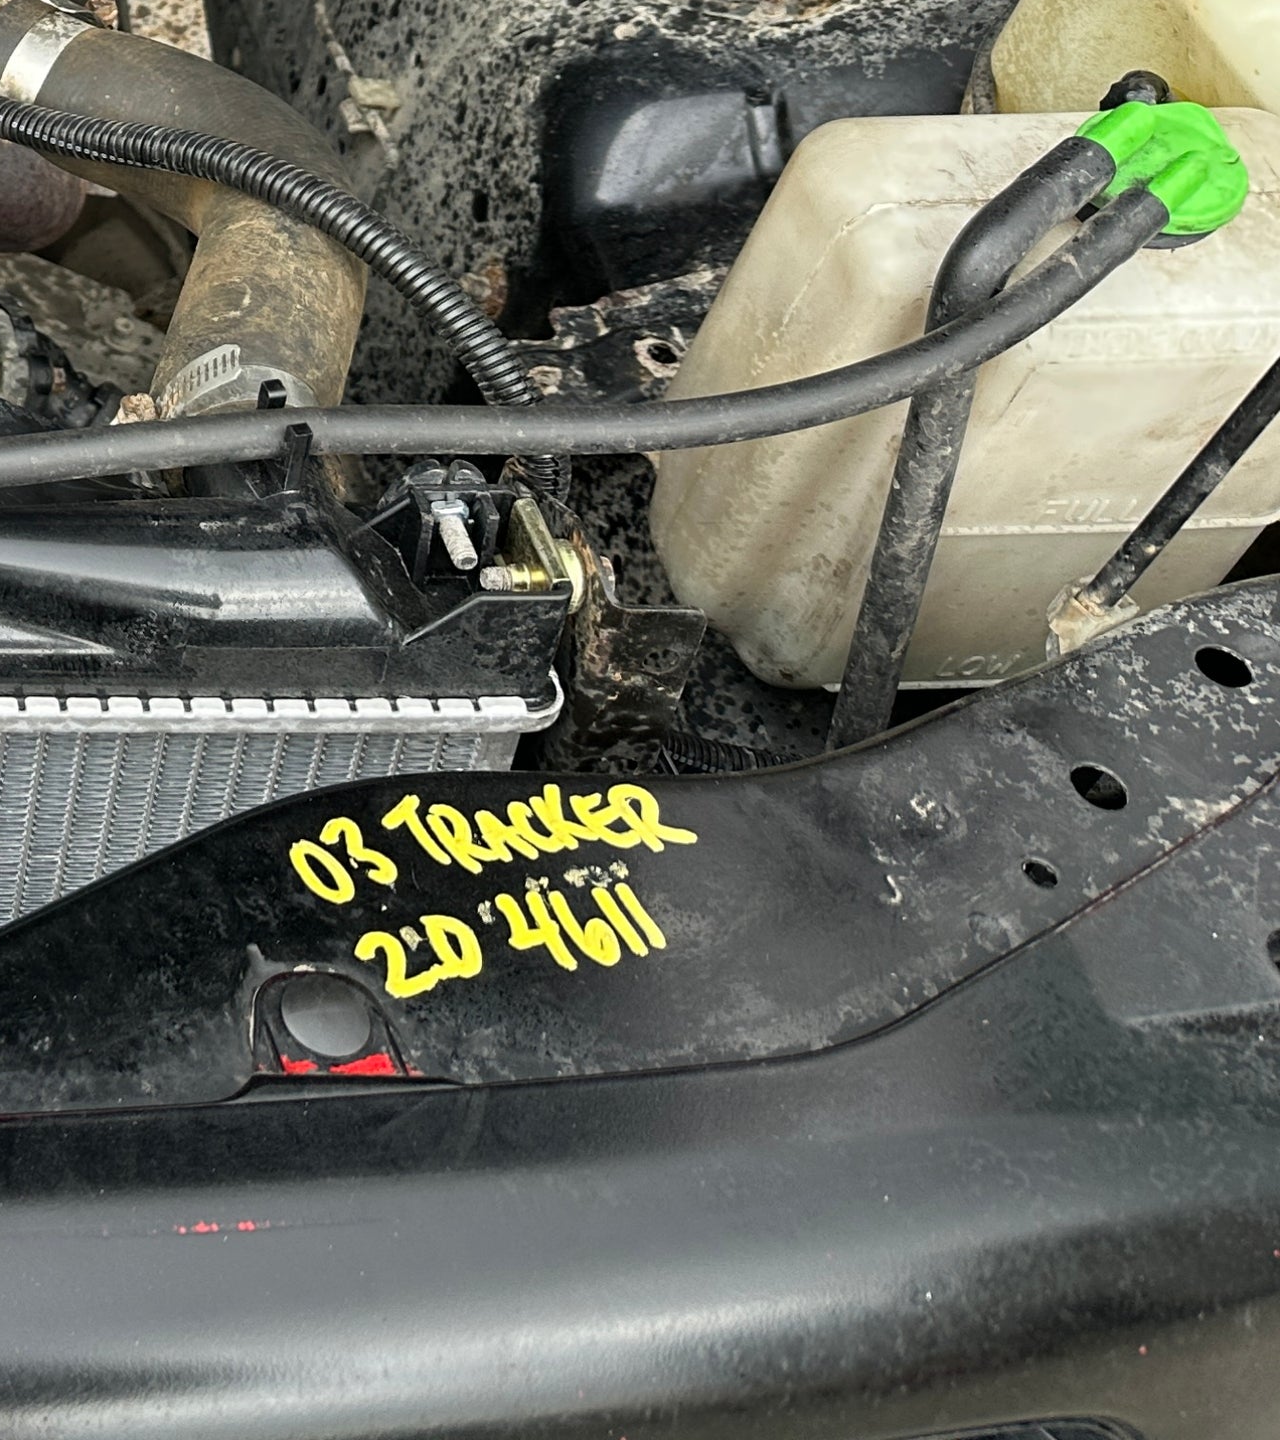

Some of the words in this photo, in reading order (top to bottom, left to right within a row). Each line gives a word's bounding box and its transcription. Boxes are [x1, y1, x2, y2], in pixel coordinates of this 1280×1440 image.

[289, 816, 398, 904] 03
[382, 782, 698, 875] TRACKER
[354, 913, 483, 999] 2D
[494, 881, 667, 971] 4611
